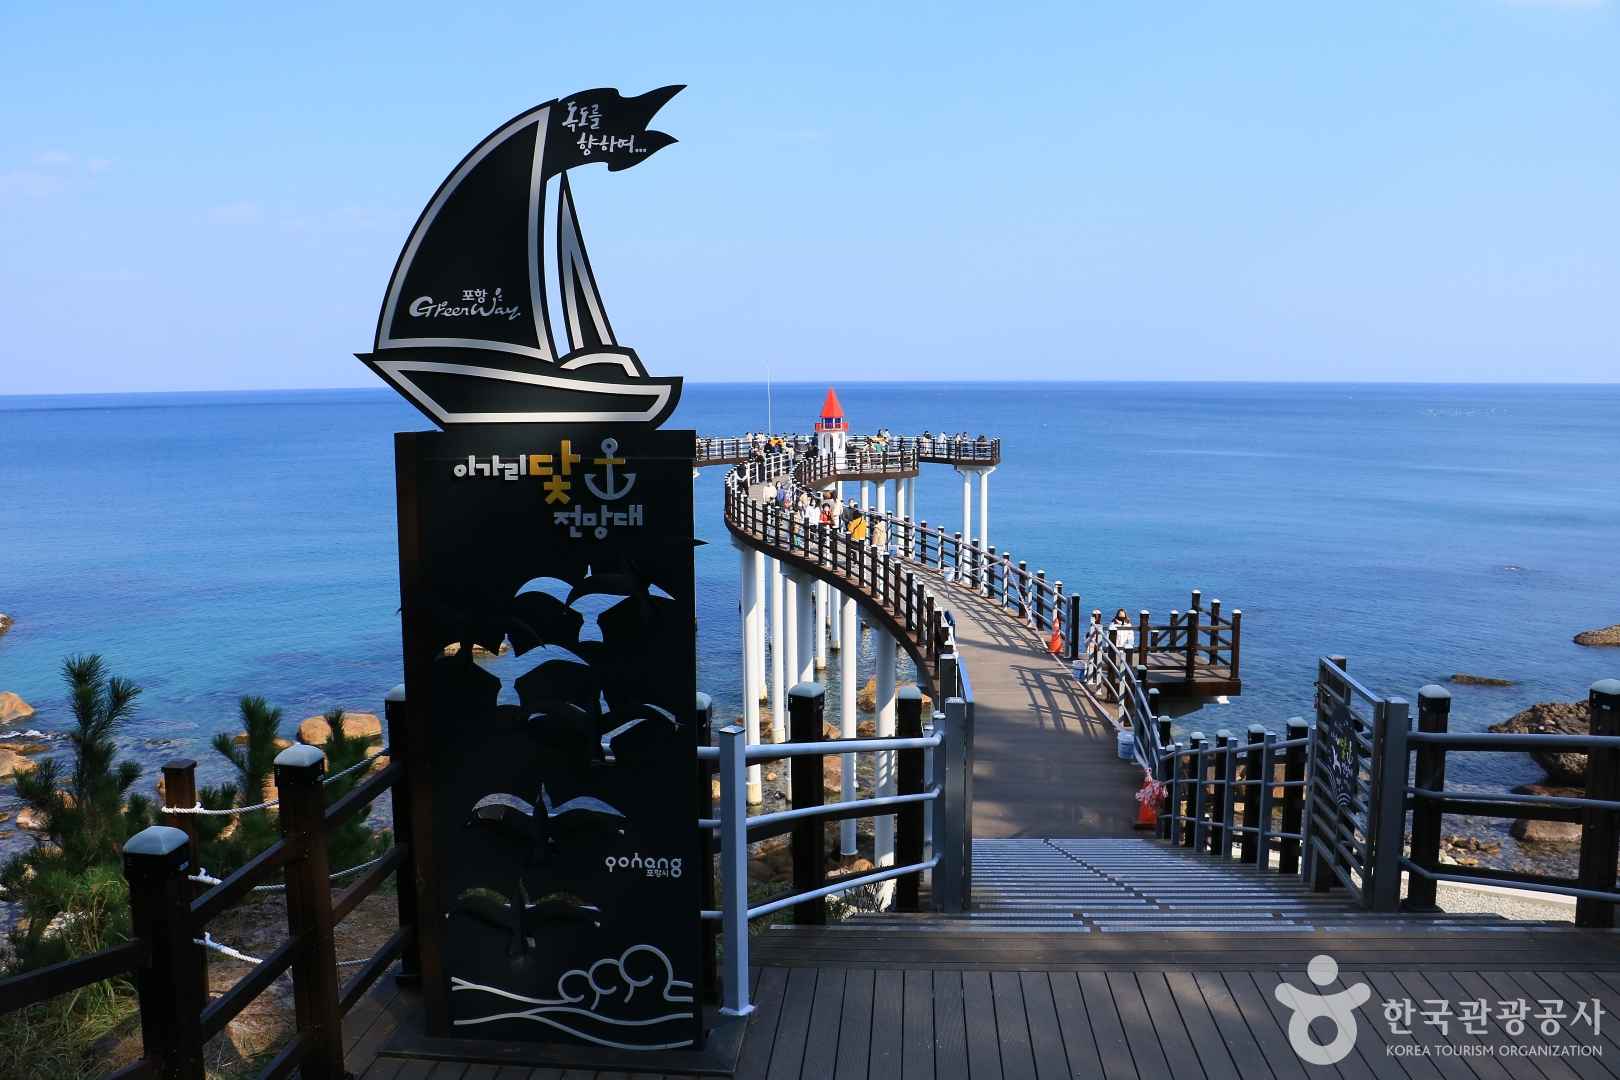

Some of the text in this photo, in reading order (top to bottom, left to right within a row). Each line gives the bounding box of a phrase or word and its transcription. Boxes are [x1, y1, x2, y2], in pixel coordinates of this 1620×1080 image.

[562, 101, 602, 132] 독도를
[462, 288, 488, 304] 포항
[553, 504, 643, 540] 전망대
[646, 868, 669, 878] 포항시
